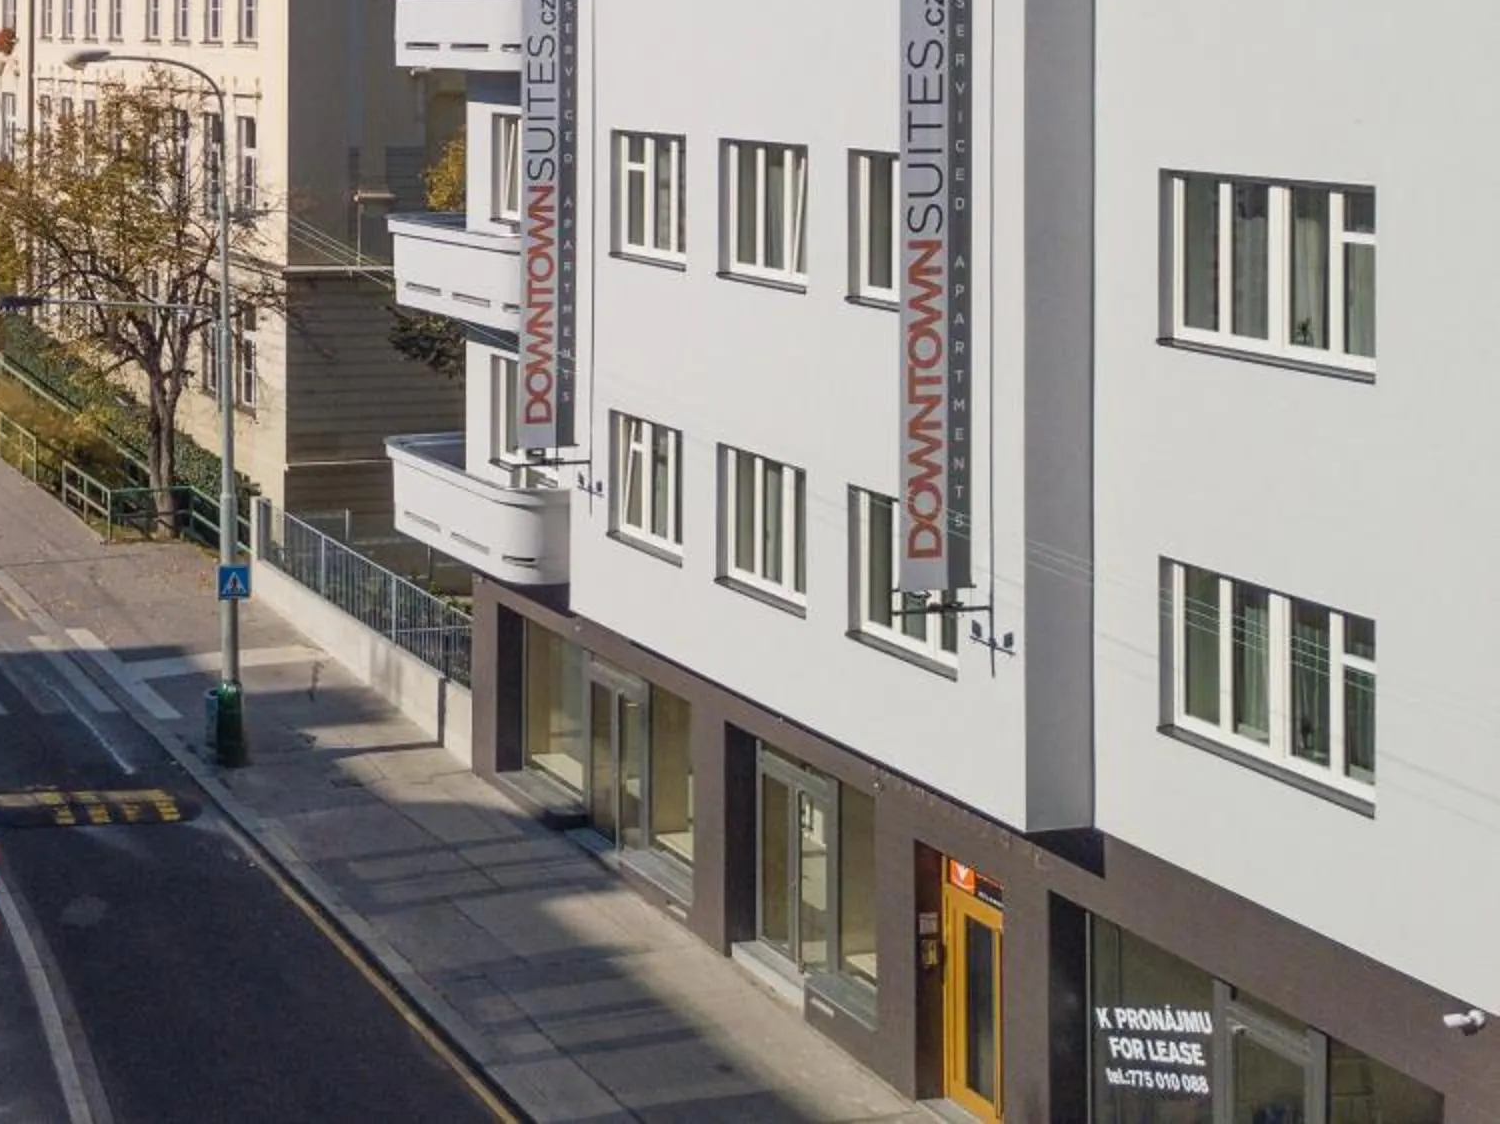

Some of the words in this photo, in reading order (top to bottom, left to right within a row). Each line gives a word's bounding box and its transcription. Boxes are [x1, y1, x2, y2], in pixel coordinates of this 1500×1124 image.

[563, 1, 574, 164] SERVICED
[953, 255, 966, 526] APARTMENTS
[1095, 1007, 1112, 1029] K
[1114, 1004, 1213, 1034] PRONÁJMU
[1108, 1036, 1146, 1061] FOR
[1146, 1039, 1206, 1066] LEASE
